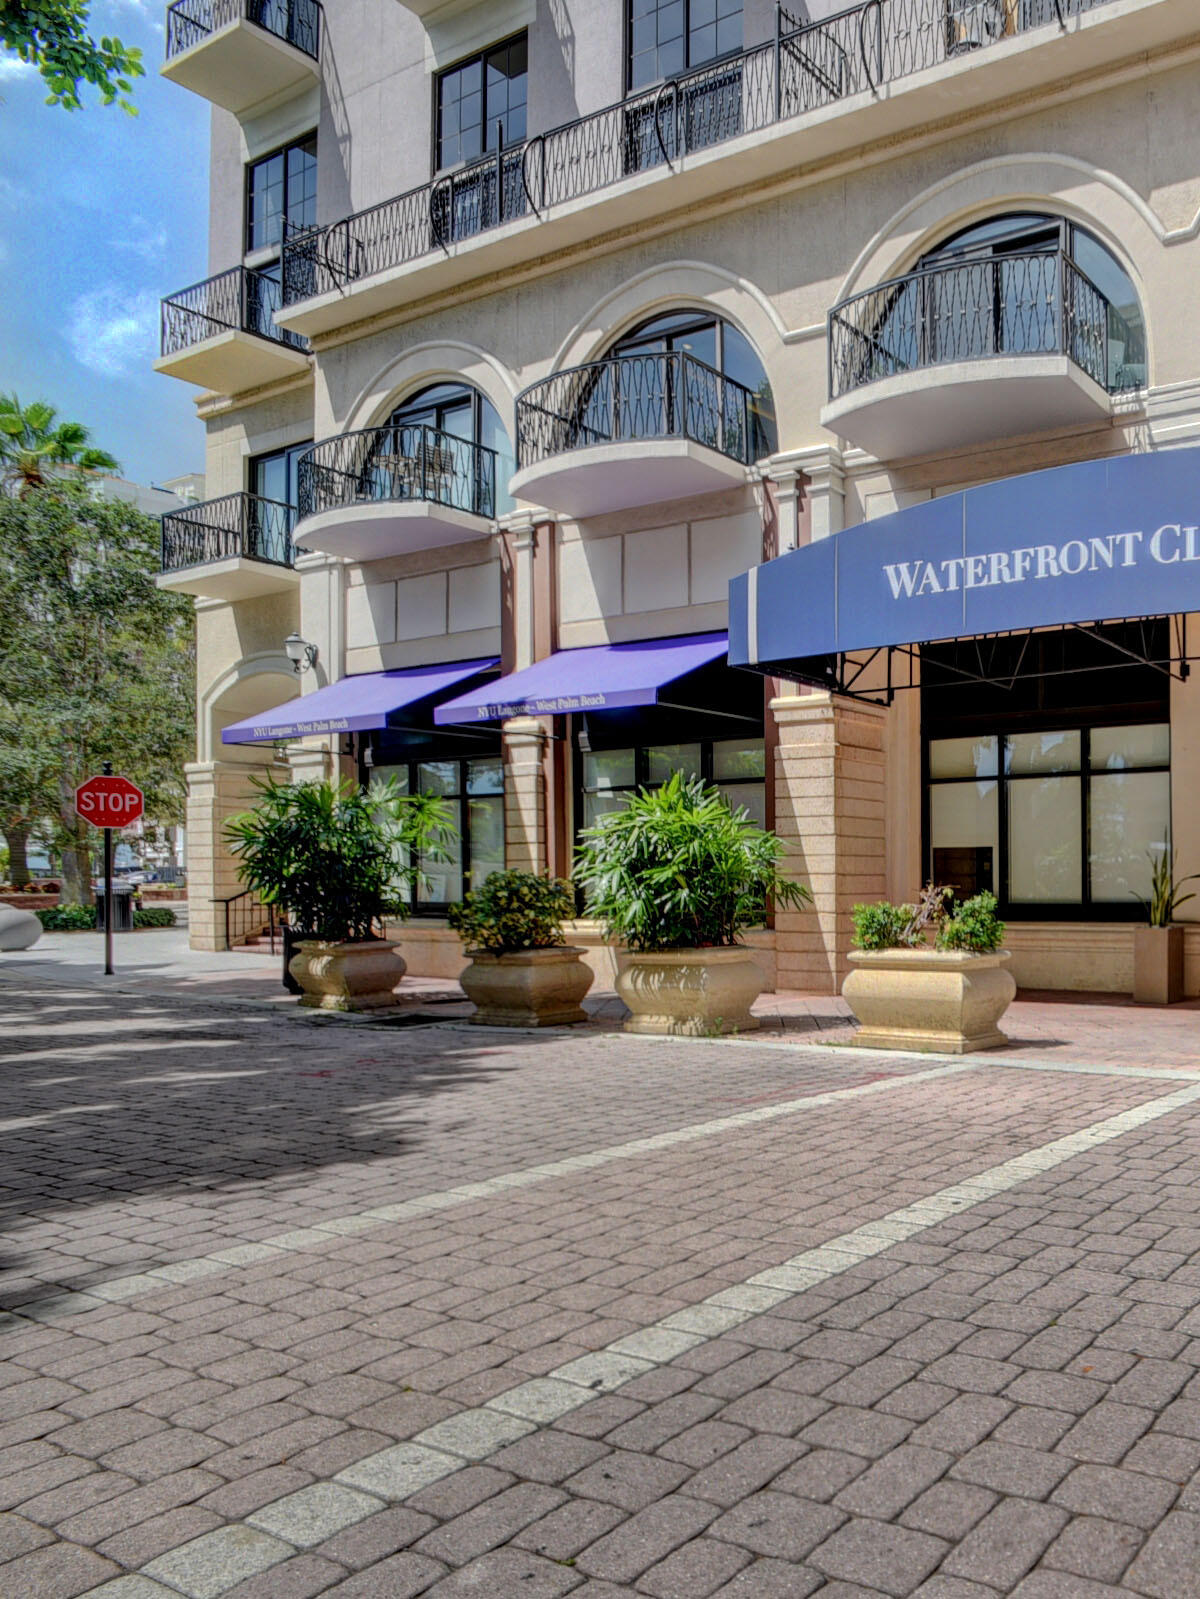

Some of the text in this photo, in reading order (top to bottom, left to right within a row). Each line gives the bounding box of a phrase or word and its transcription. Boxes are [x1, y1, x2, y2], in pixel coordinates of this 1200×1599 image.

[883, 531, 1143, 600] WATERFRONT
[478, 706, 497, 718] NYU
[498, 703, 530, 716] Langone
[536, 700, 556, 712] West
[557, 697, 579, 709] Palm
[581, 694, 606, 706] Beach
[254, 727, 268, 737] NYU
[268, 726, 293, 736] Langone
[297, 721, 312, 732] West
[313, 721, 329, 731] Palm
[329, 718, 349, 729] Beach
[80, 791, 139, 812] STOP
